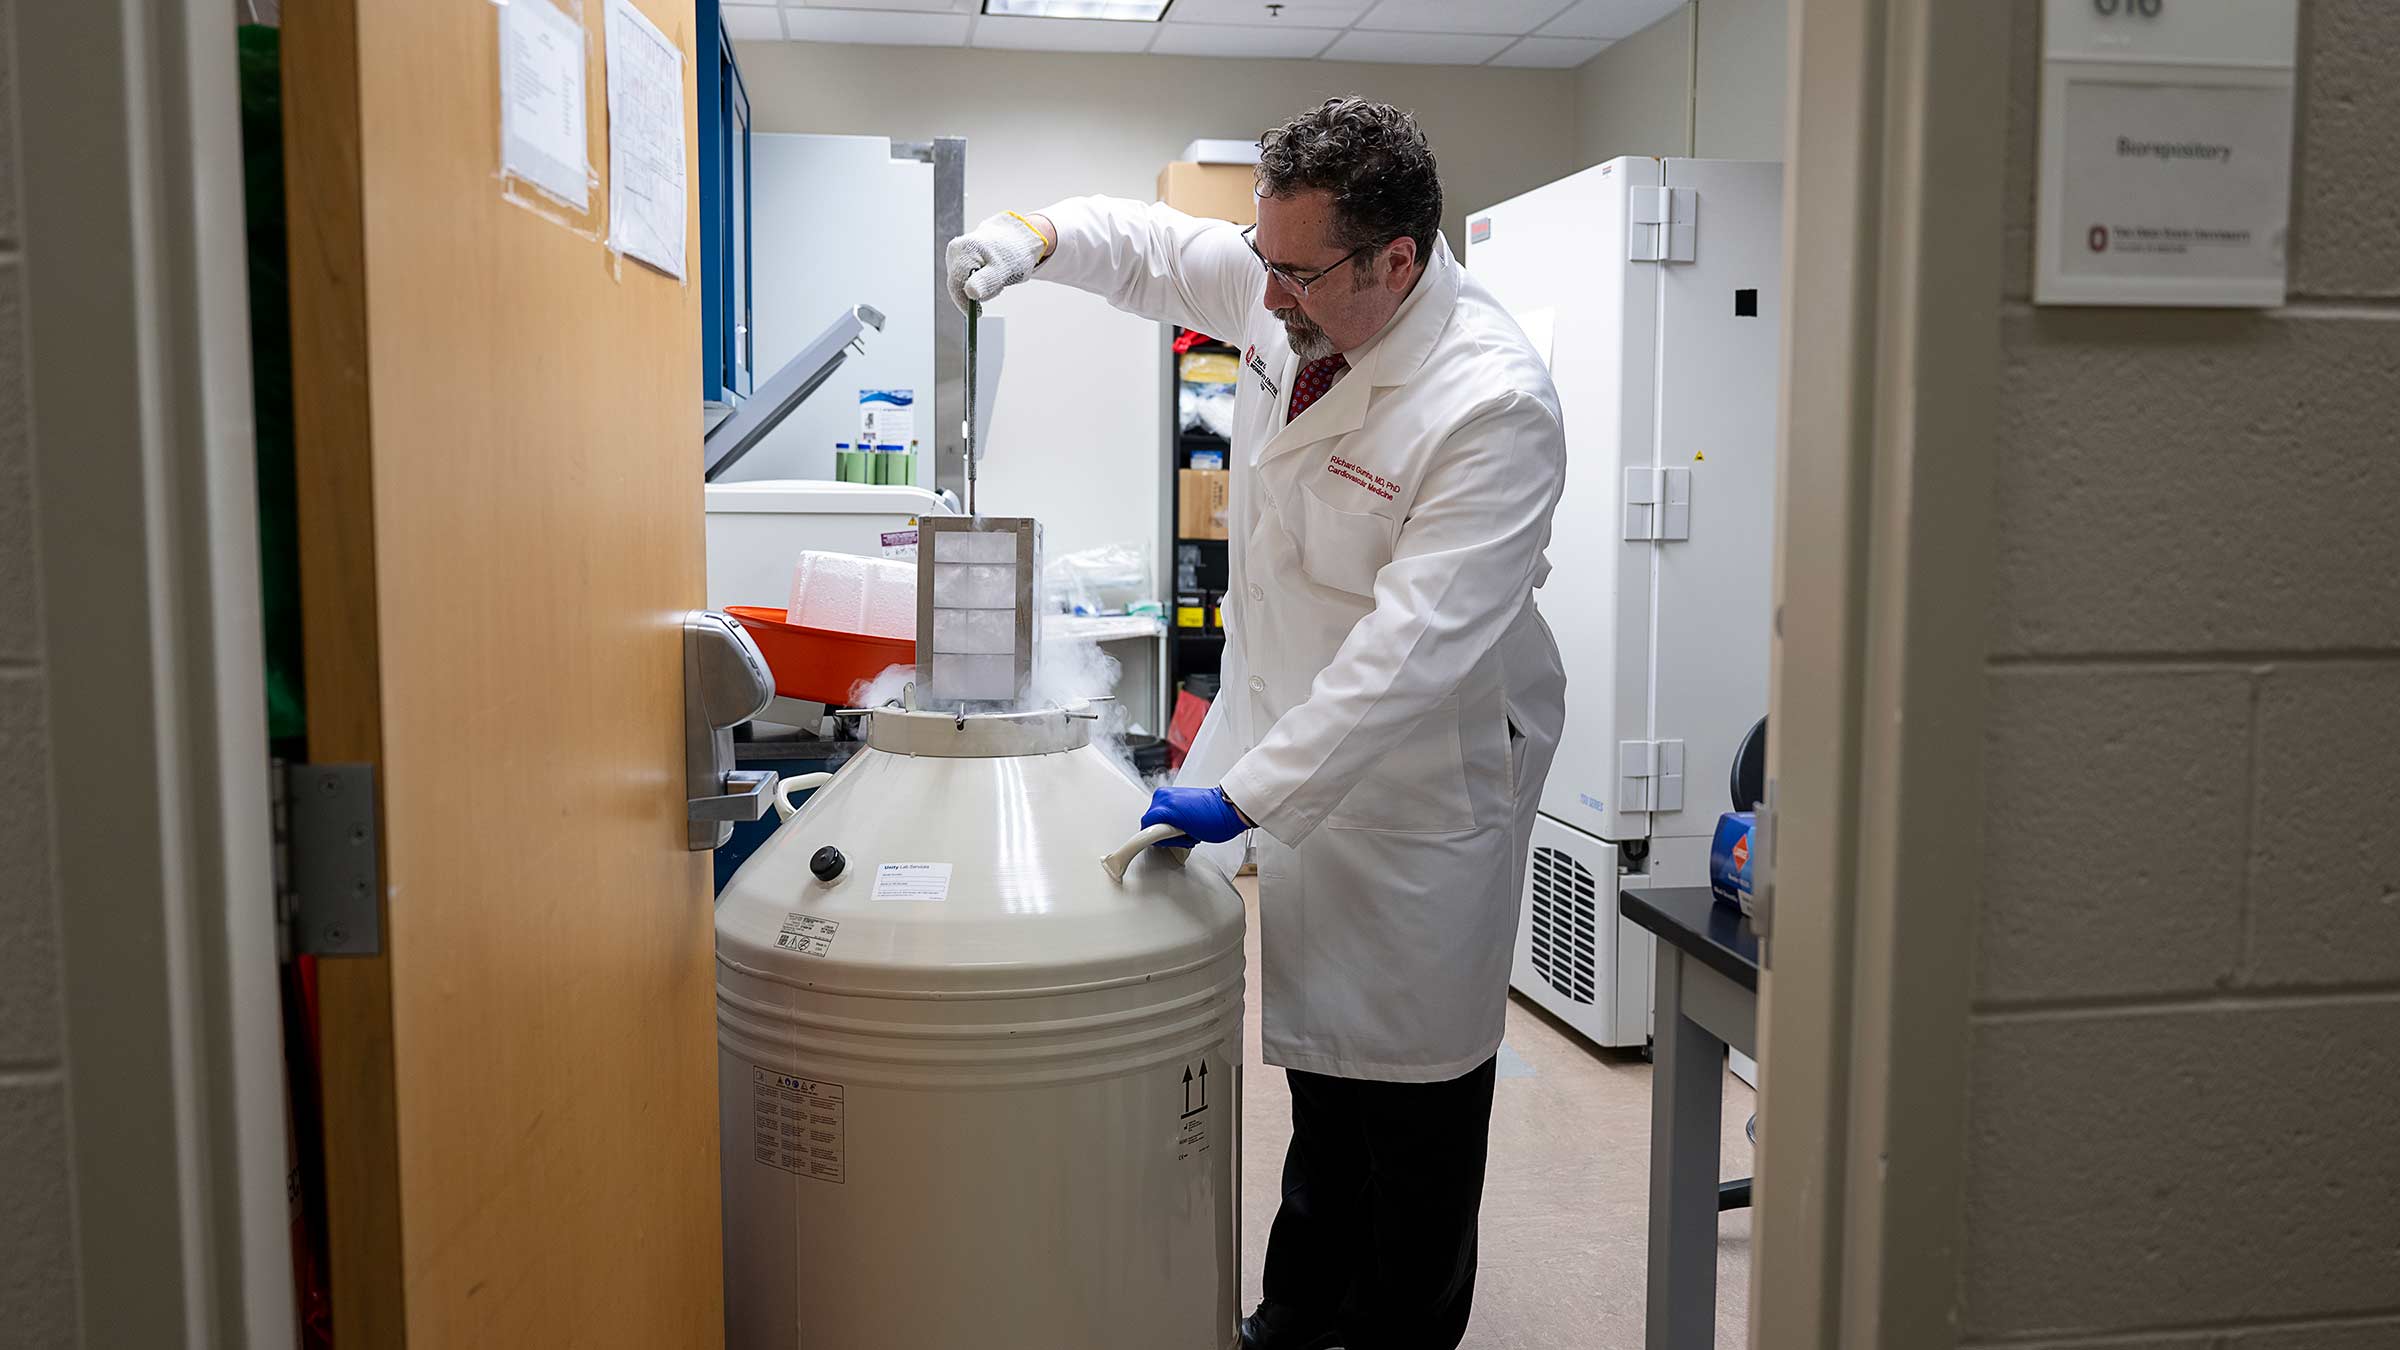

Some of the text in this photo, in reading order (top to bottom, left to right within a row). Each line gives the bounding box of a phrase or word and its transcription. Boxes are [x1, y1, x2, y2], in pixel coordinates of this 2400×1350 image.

[1330, 455, 1356, 471] Richard
[1386, 481, 1401, 493] PhD
[1367, 483, 1394, 501] Medicine
